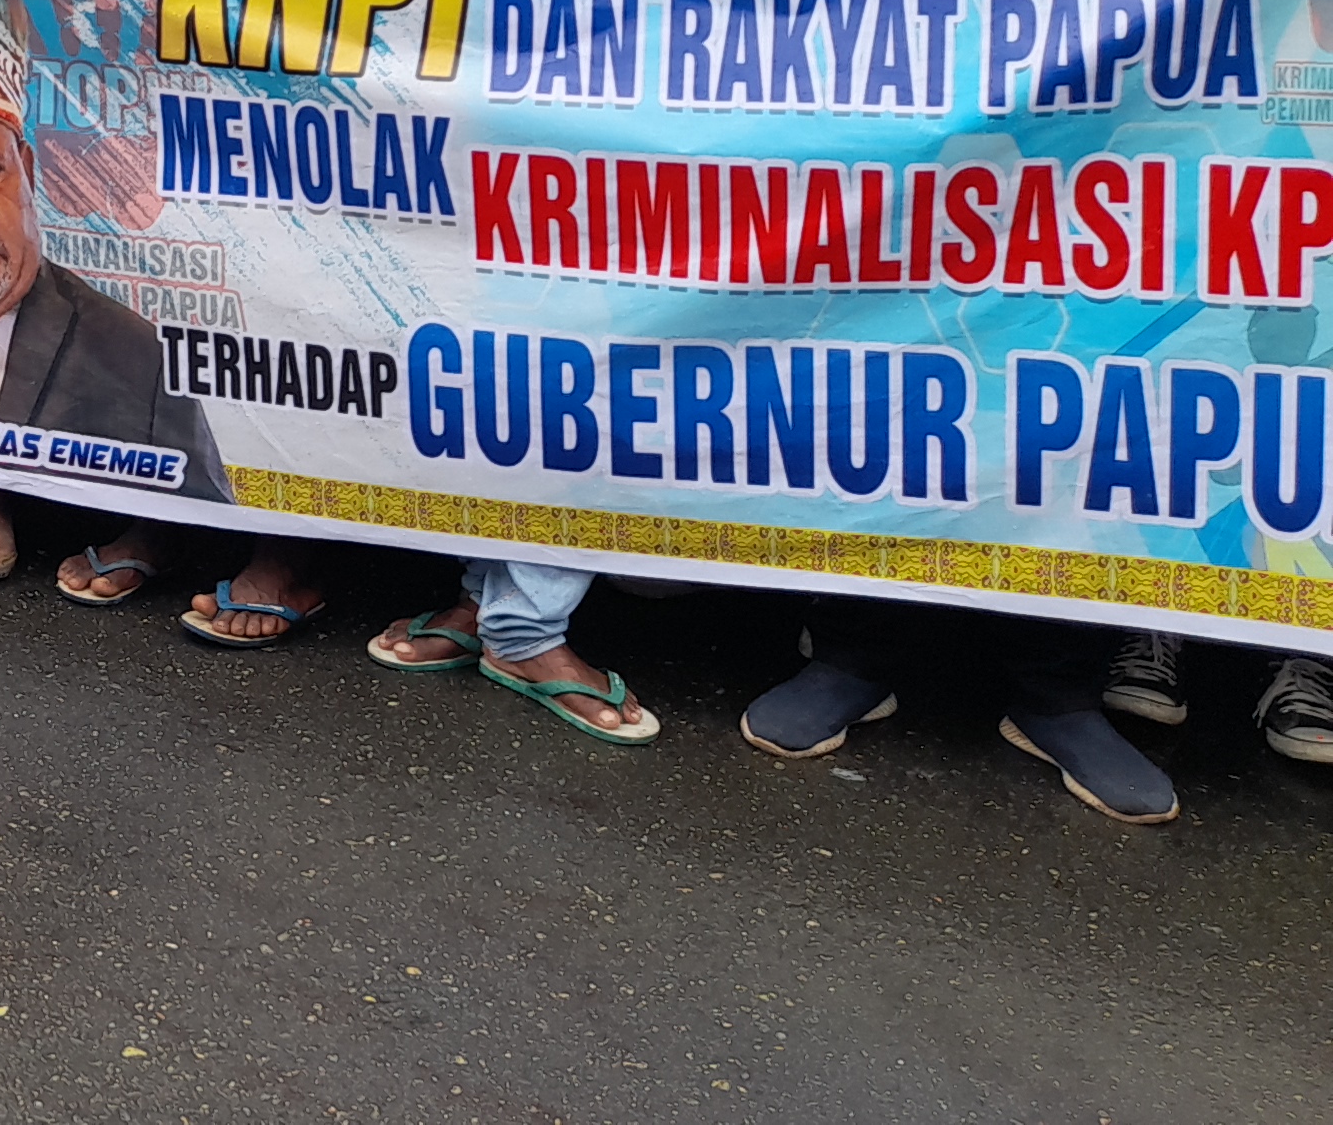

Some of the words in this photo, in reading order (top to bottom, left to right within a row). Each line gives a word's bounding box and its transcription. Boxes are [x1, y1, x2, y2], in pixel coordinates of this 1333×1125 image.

[161, 93, 455, 217] MENOLAK
[470, 151, 1164, 292] KRIMINALISASI
[1207, 165, 1333, 299] KP
[140, 288, 240, 329] PAPUA
[48, 438, 182, 483] ENEMBE
[161, 325, 397, 418] TERHADAP
[408, 323, 970, 503] GUBERNUR
[1015, 357, 1333, 535] PAPU
